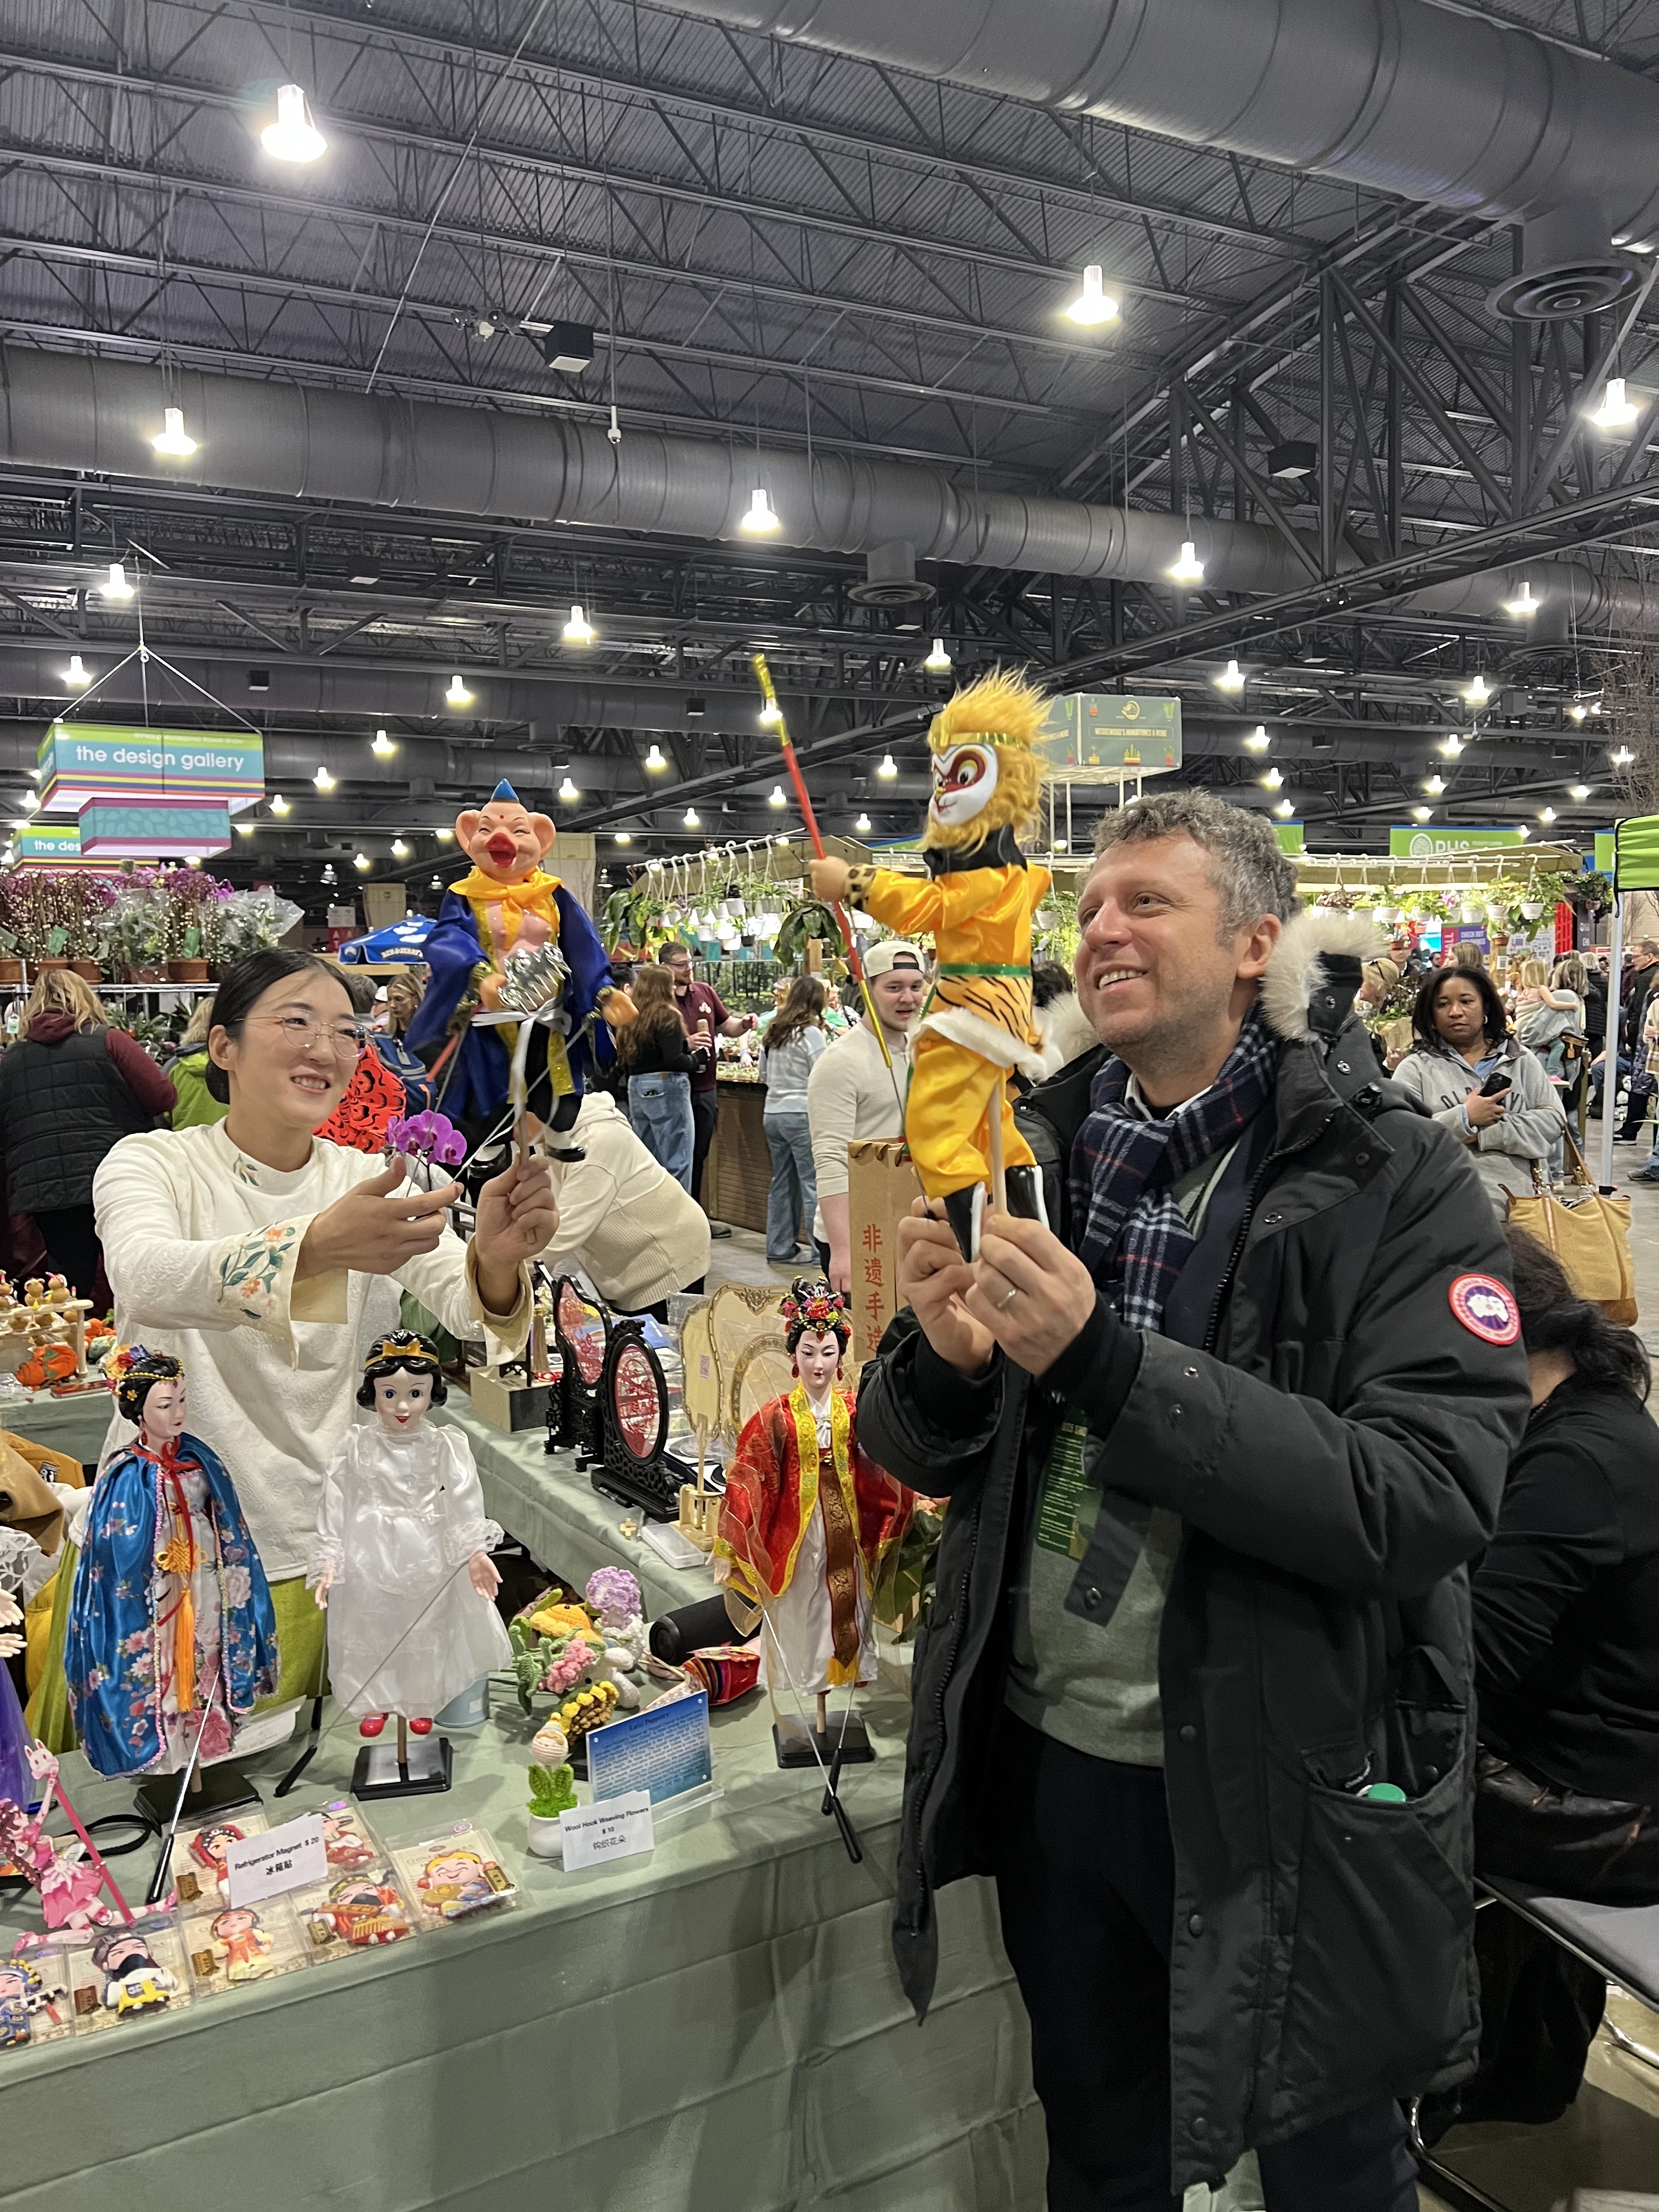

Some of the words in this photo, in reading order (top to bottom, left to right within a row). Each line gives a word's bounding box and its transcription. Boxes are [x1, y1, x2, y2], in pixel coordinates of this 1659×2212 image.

[76, 746, 107, 761] the
[113, 748, 175, 769] design
[181, 752, 244, 771] gallery
[34, 840, 55, 850] the
[58, 841, 81, 851] des
[565, 1824, 581, 1832] Wool
[582, 1820, 597, 1828] Hook
[599, 1814, 625, 1824] Weaving
[626, 1808, 648, 1817] Flowers
[235, 1853, 275, 1870] Refrigerator
[276, 1843, 302, 1855] Magnet
[311, 1836, 319, 1844] 20
